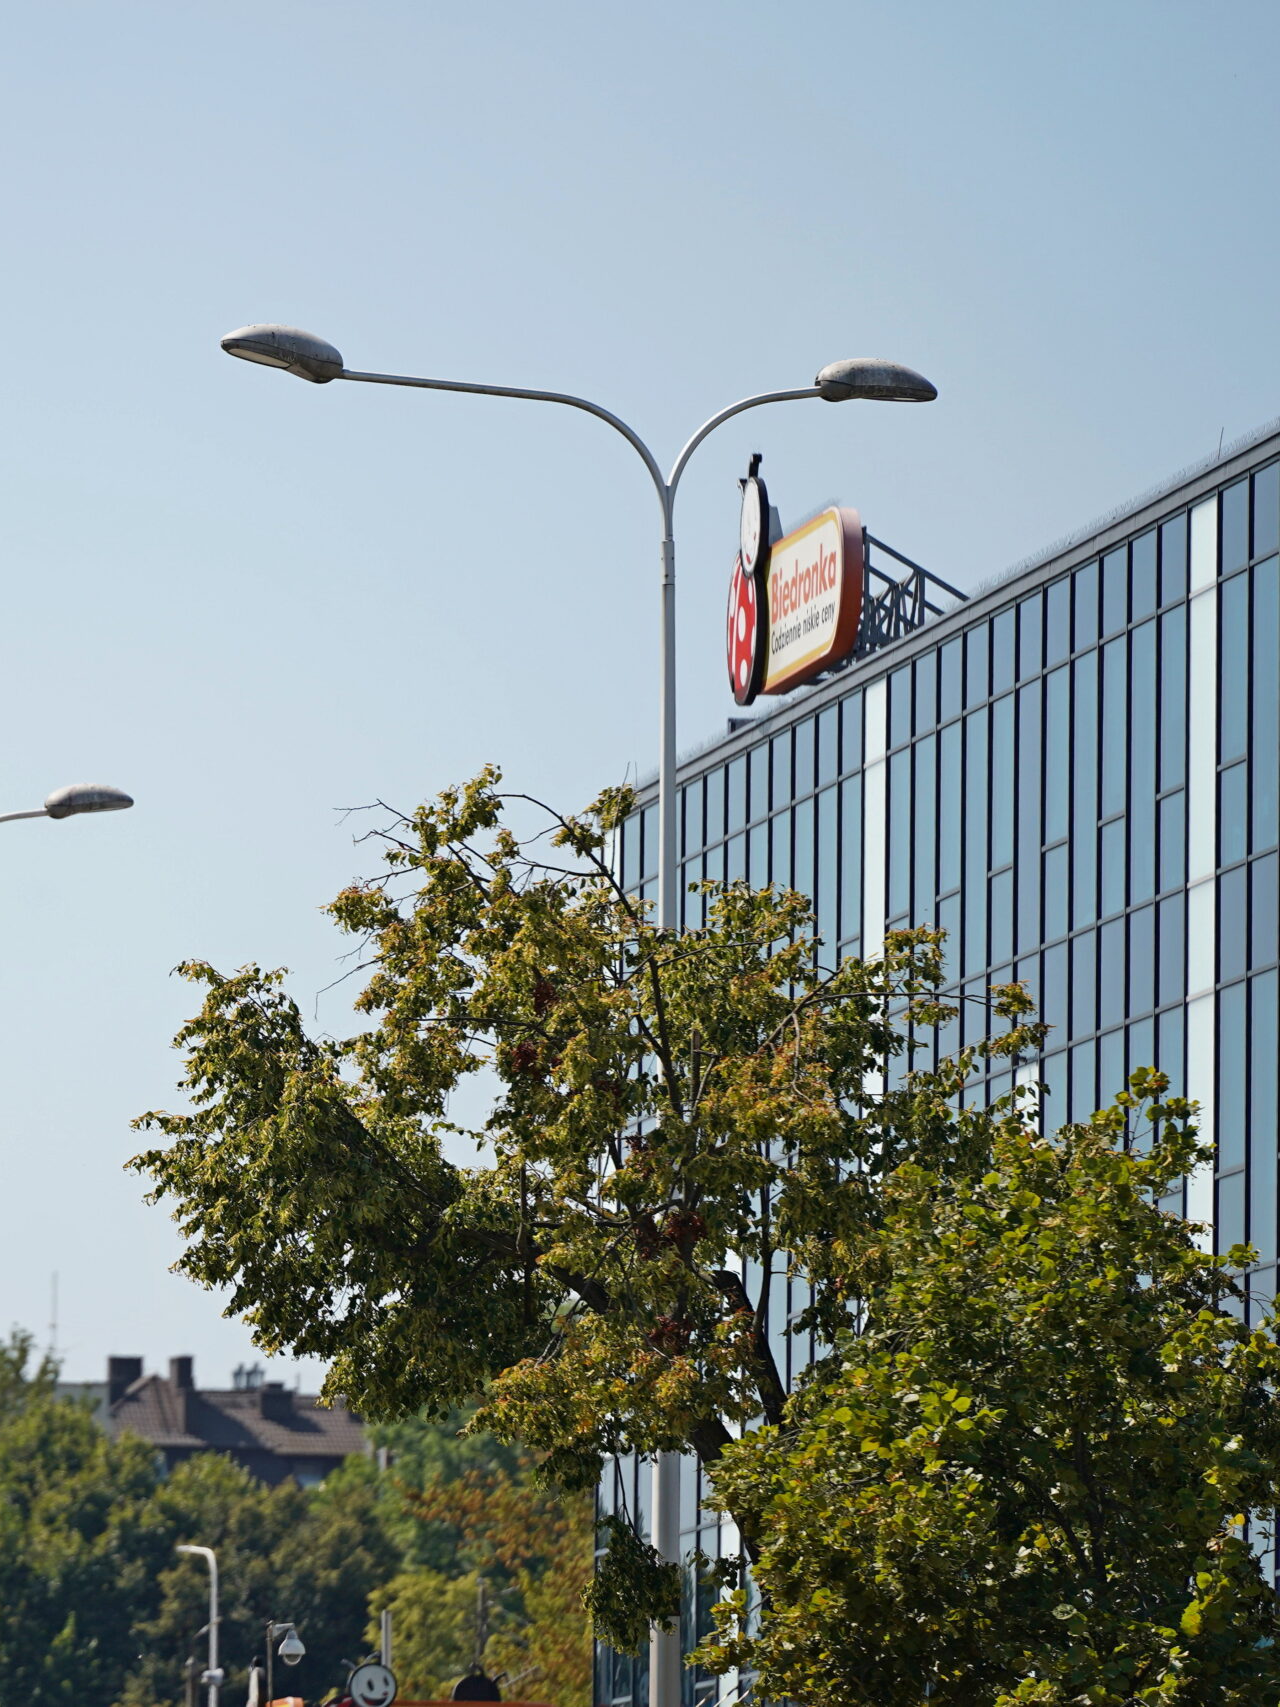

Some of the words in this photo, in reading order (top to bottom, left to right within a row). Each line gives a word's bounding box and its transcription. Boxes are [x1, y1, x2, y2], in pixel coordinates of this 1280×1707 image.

[771, 543, 837, 625] Biedronka
[771, 615, 802, 655] Codziennie
[802, 603, 820, 636] niskie
[821, 601, 836, 624] ceny
